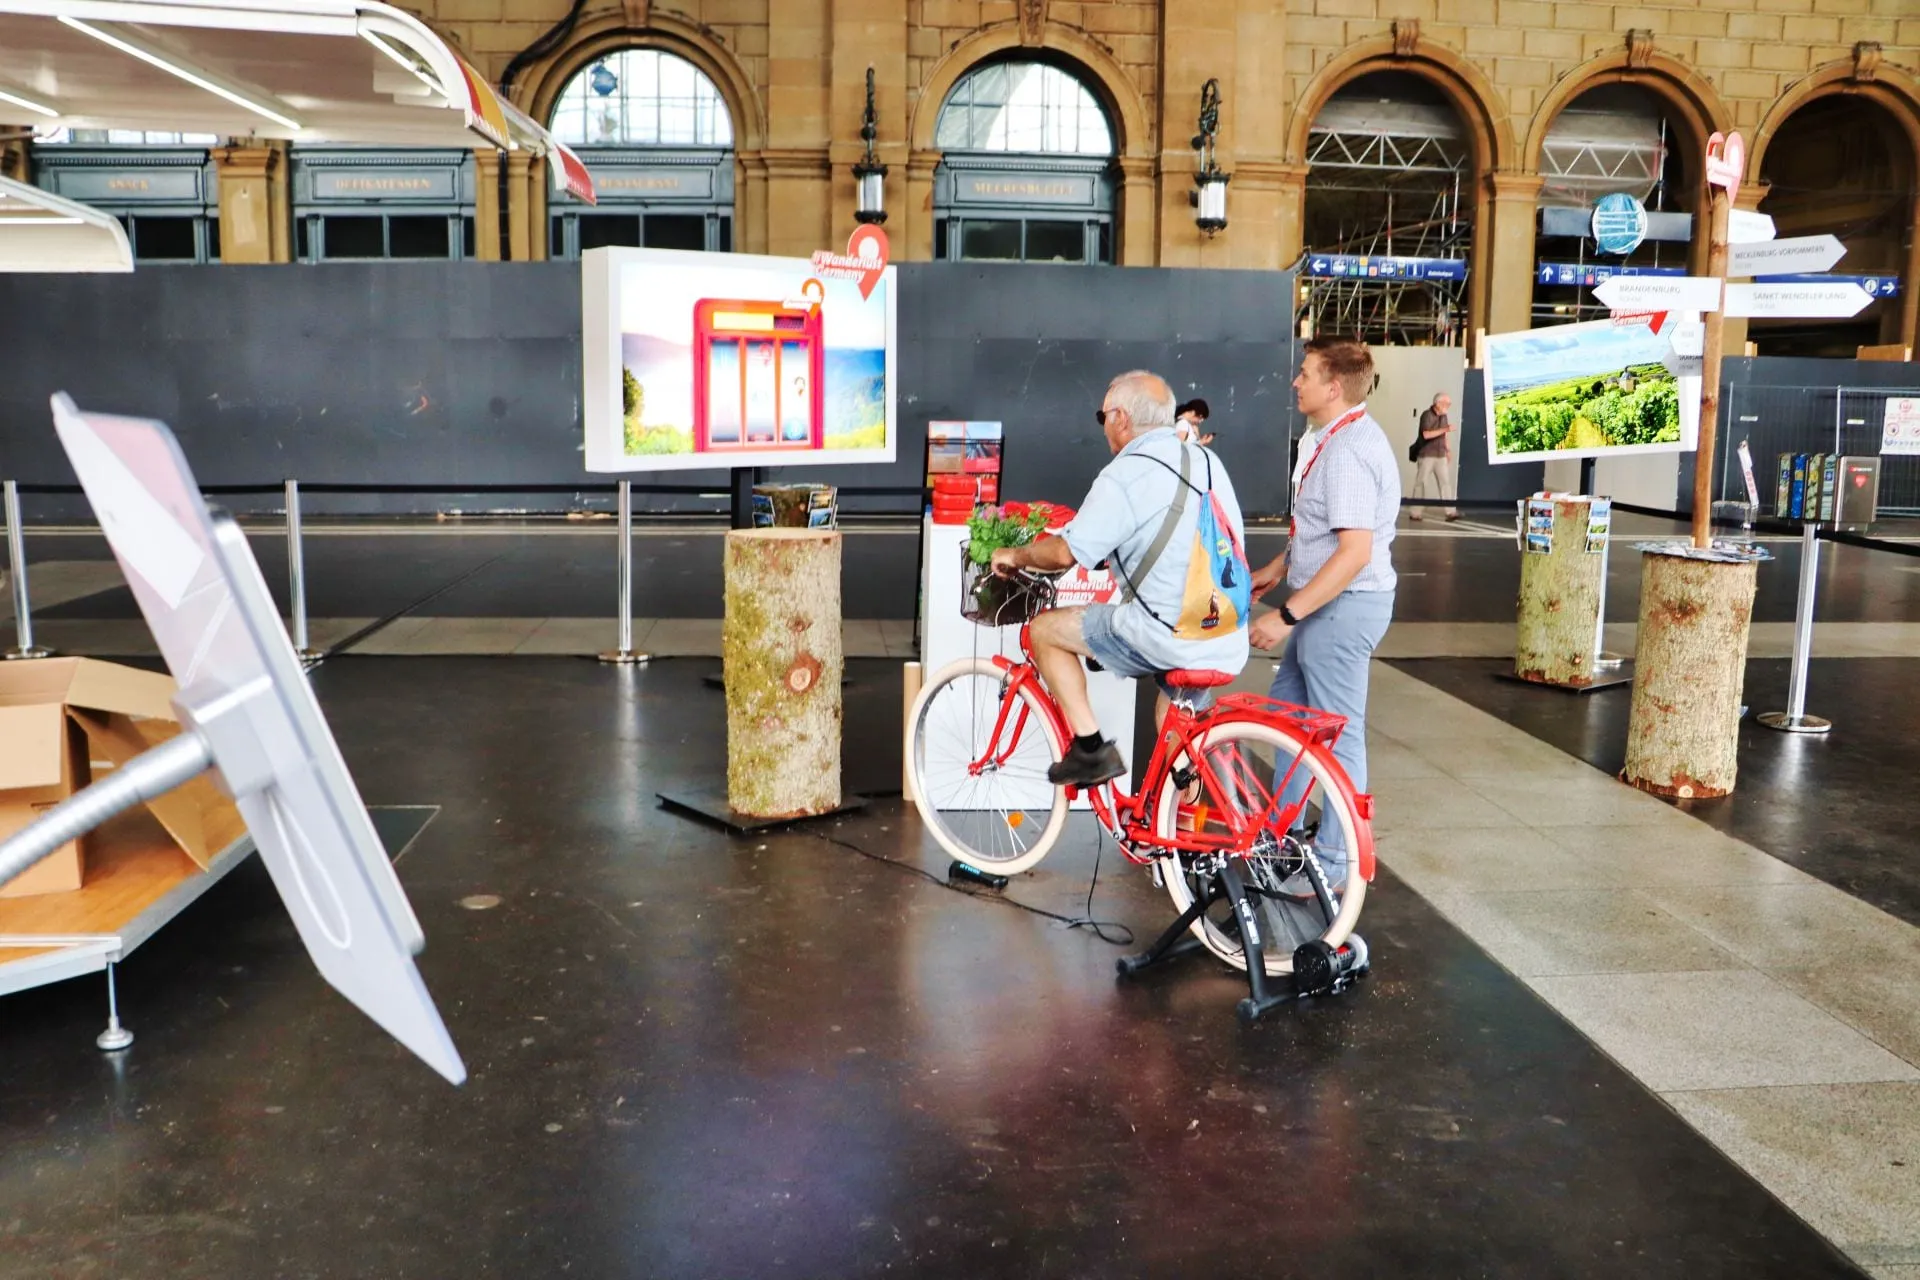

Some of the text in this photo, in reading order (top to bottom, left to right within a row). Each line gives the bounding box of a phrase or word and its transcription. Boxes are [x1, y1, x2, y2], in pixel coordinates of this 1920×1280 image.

[812, 250, 883, 270] #Wanderlust
[815, 264, 866, 284] Germany
[1619, 284, 1681, 294] BRANDENBURG
